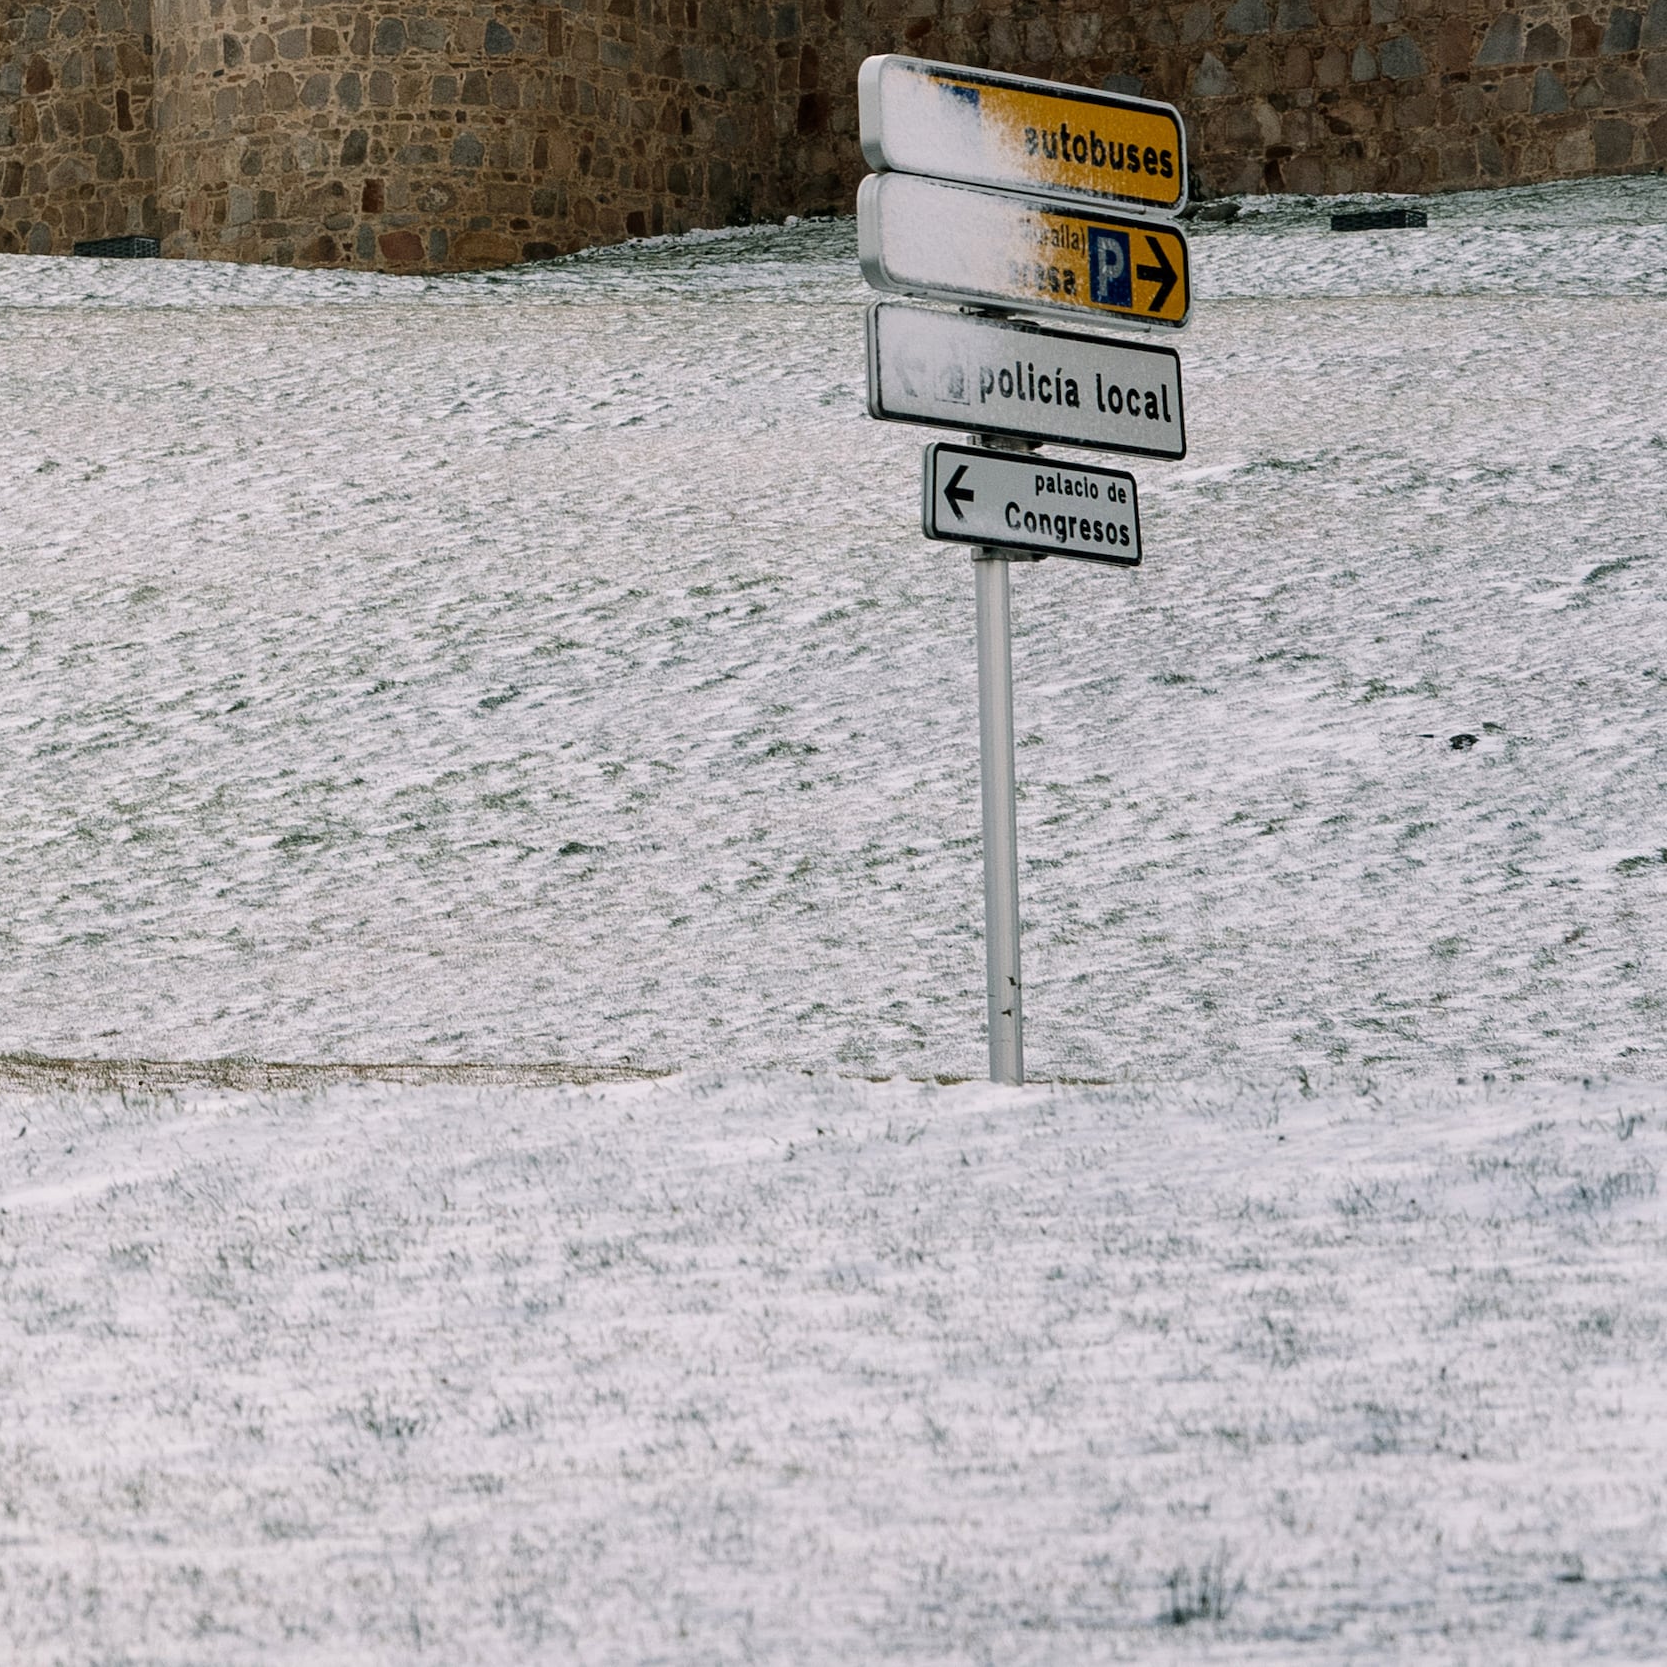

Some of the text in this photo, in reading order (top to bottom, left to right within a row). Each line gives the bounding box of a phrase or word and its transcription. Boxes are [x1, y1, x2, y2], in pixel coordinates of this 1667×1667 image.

[1025, 122, 1173, 179] autobuses
[979, 361, 1172, 423] policía local
[1035, 472, 1127, 504] palacio de
[1005, 501, 1130, 547] Congresos
